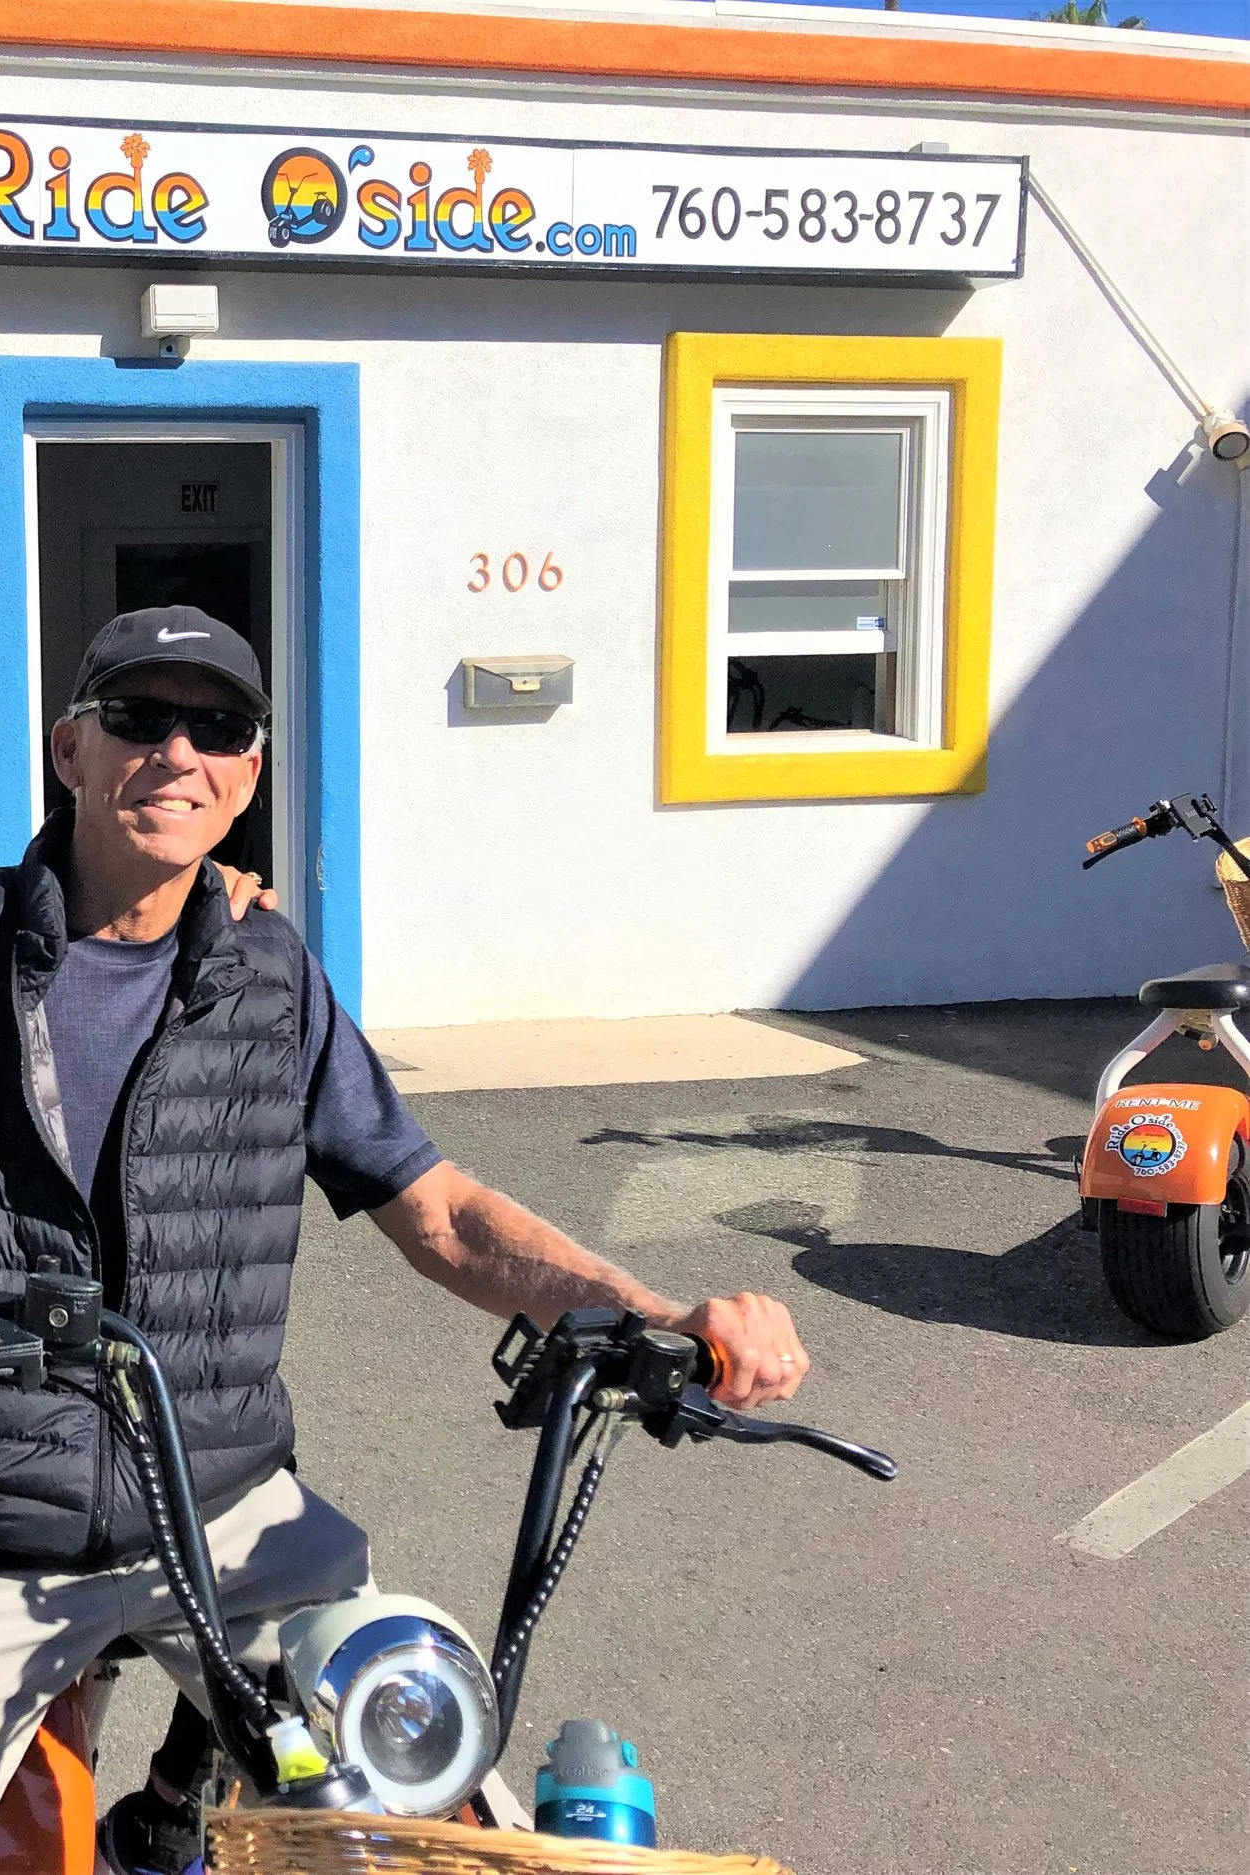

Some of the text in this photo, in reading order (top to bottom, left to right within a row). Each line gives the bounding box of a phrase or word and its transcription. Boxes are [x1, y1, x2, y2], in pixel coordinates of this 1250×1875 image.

[651, 185, 1003, 248] 760-583-8737
[181, 484, 218, 512] EXIT
[467, 551, 563, 593] 306
[1115, 1098, 1202, 1111] RENT ME
[1106, 1124, 1131, 1150] Ride
[1135, 1140, 1186, 1176] 760-583-8737
[576, 1802, 594, 1814] 24
